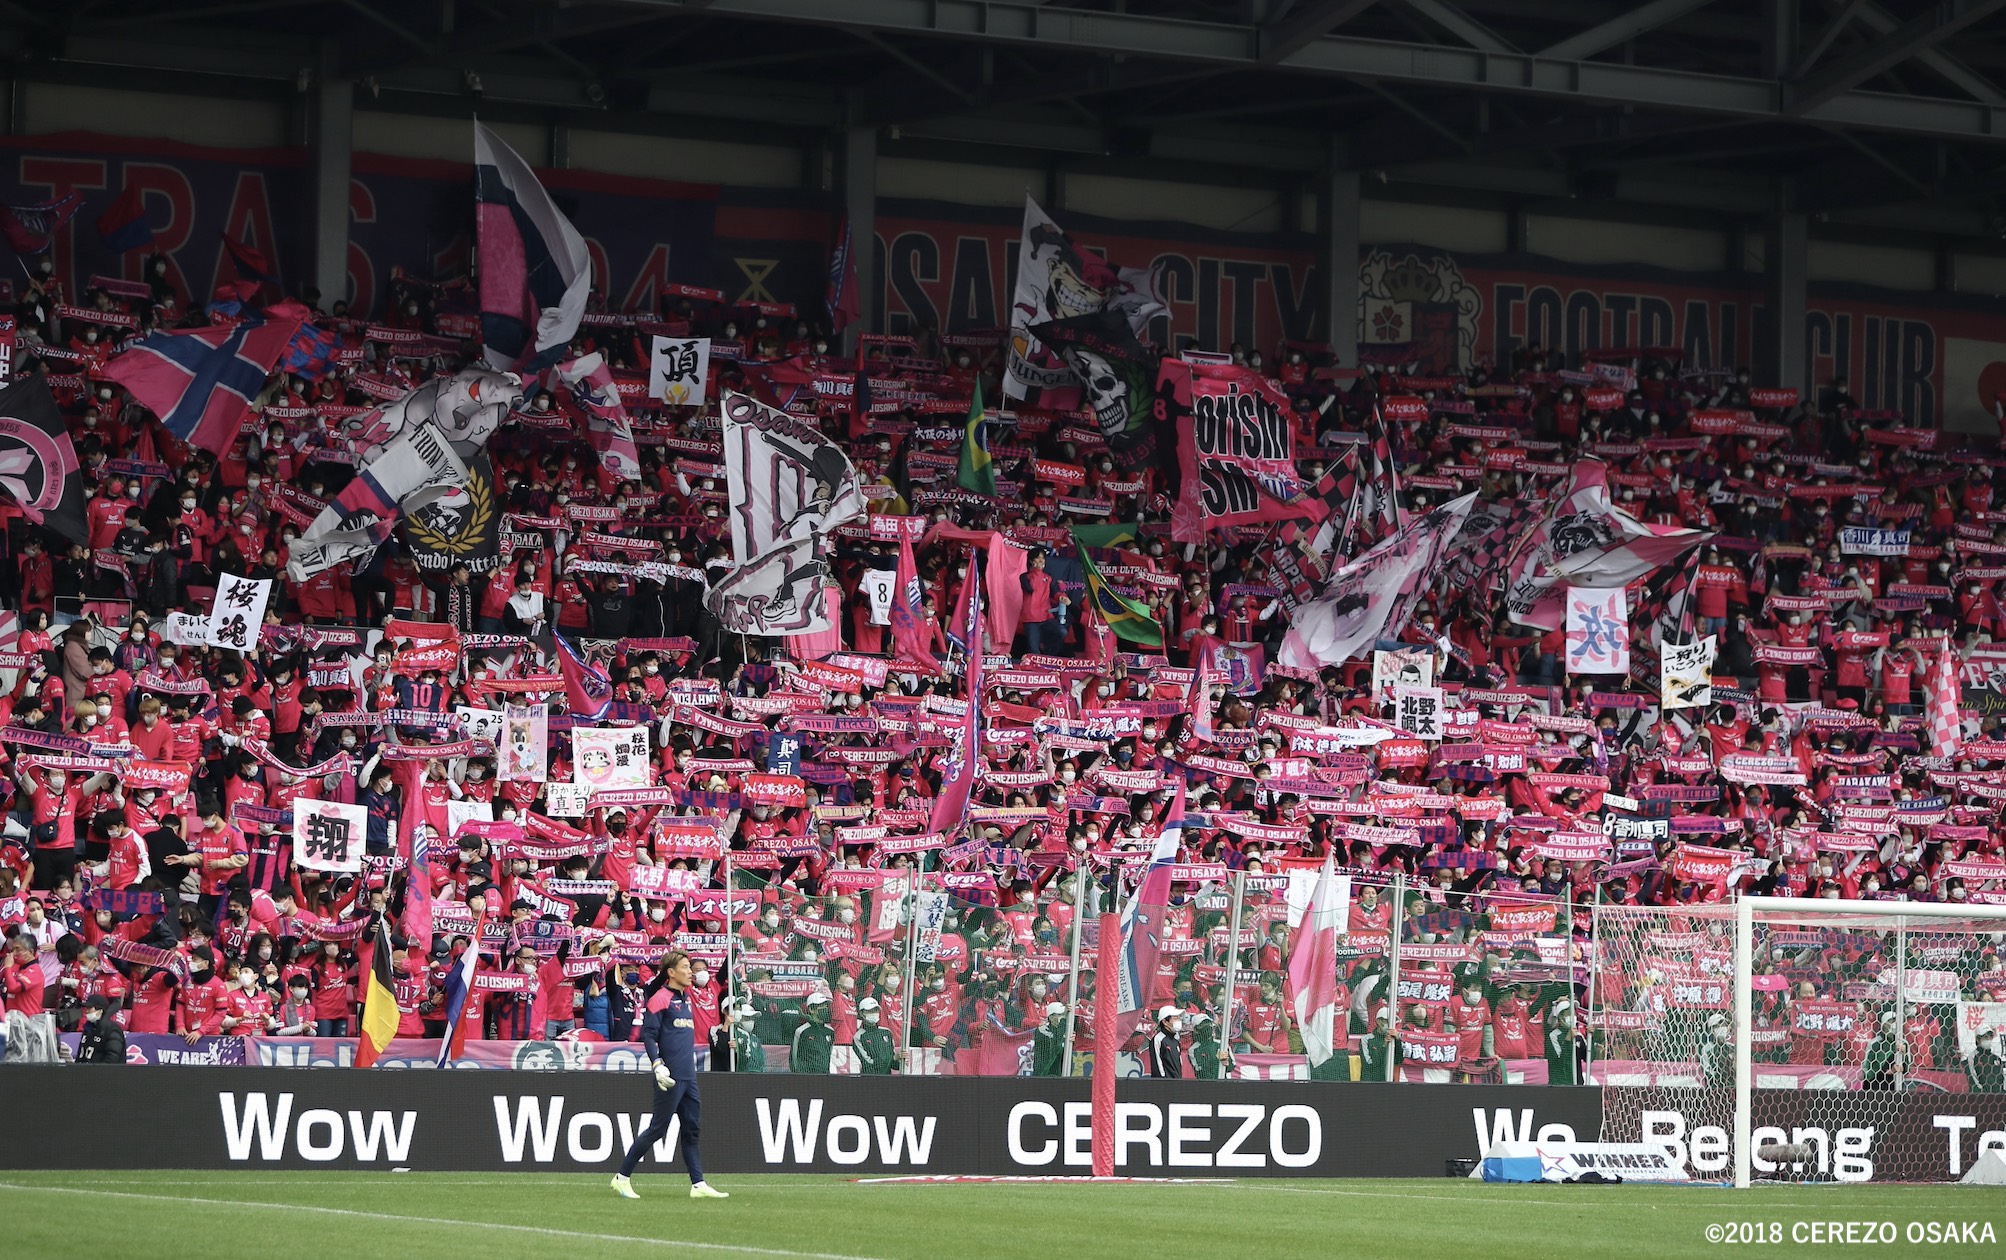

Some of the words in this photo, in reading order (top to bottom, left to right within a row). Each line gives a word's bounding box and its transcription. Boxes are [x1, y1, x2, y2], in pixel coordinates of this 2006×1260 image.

[20, 156, 377, 325] TRA
[70, 308, 101, 320] CEREZO
[104, 312, 131, 324] OSAKA
[661, 340, 699, 384] 頂
[597, 534, 626, 546] CEREZO
[629, 537, 654, 549] OSAKA
[1845, 527, 1870, 543] 香川
[1883, 528, 1909, 543] 真司
[878, 583, 888, 603] 8
[1800, 599, 1825, 609] OSAKA
[1031, 655, 1064, 667] CEREZO
[1068, 656, 1096, 668] OSAKA
[1765, 650, 1792, 660] CEREZO
[146, 675, 175, 689] CEREZO
[178, 678, 202, 691] OSAKA
[996, 672, 1027, 683] CEREZO
[1031, 673, 1057, 684] OSAKA
[411, 684, 432, 704] 10
[1056, 706, 1066, 717] 19
[1401, 697, 1436, 715] 北野
[321, 714, 364, 726] OSAKA
[385, 710, 422, 721] CEREZO
[491, 714, 503, 724] 25
[839, 721, 876, 731] KAGAWA
[32, 755, 72, 767] CEREZO
[76, 757, 110, 768] OSAKA
[777, 738, 791, 775] 真司
[1735, 757, 1774, 767] CEREZO
[351, 766, 357, 776] 8
[985, 773, 1018, 783] CEREZO
[1021, 773, 1048, 783] OSAKA
[1099, 774, 1129, 787] CEREZO
[1132, 776, 1156, 789] OSAKA
[549, 783, 590, 795] おかえり
[597, 791, 633, 803] CEREZO
[636, 790, 666, 802] OSAKA
[556, 796, 588, 815] 真司
[1310, 801, 1344, 813] CEREZO
[1347, 802, 1376, 814] OSAKA
[1845, 806, 1871, 818] CEREZO
[1228, 821, 1266, 837] CEREZO
[1270, 825, 1301, 840] OSAKA
[1602, 814, 1611, 836] 8
[1616, 819, 1668, 839] 香川真司
[1841, 821, 1871, 833] CEREZO
[305, 814, 348, 861] 翔
[1824, 835, 1850, 845] CEREZO
[1852, 835, 1874, 847] OSAKA
[522, 844, 556, 857] CEREZO
[559, 845, 587, 858] OSAKA
[1566, 848, 1595, 860] OSAKA
[1783, 843, 1792, 854] 10
[1191, 867, 1224, 879] OSAKA
[1949, 865, 1979, 877] CEREZO
[635, 866, 664, 887] 北野
[668, 867, 699, 890] 颯太
[820, 923, 852, 939] OSAKA
[226, 932, 241, 947] 20
[1171, 940, 1200, 953] OSAKA
[1337, 947, 1365, 955] FOOTBALL
[1434, 947, 1466, 957] OSAKA
[1539, 947, 1566, 957] HOME
[1023, 958, 1056, 970] CEREZO
[788, 966, 818, 976] OSAKA
[493, 977, 525, 990] OSAKA
[1398, 981, 1421, 1000] 西尾
[158, 1049, 179, 1065] WE
[180, 1049, 208, 1065] ARE
[219, 1093, 418, 1162] Wow
[493, 1096, 681, 1163] Wow
[756, 1098, 937, 1165] Wow
[1008, 1102, 1322, 1168] CEREZO
[1642, 1110, 1875, 1182] Beong
[1934, 1115, 2006, 1174] T
[1570, 1153, 1669, 1168] WINNER
